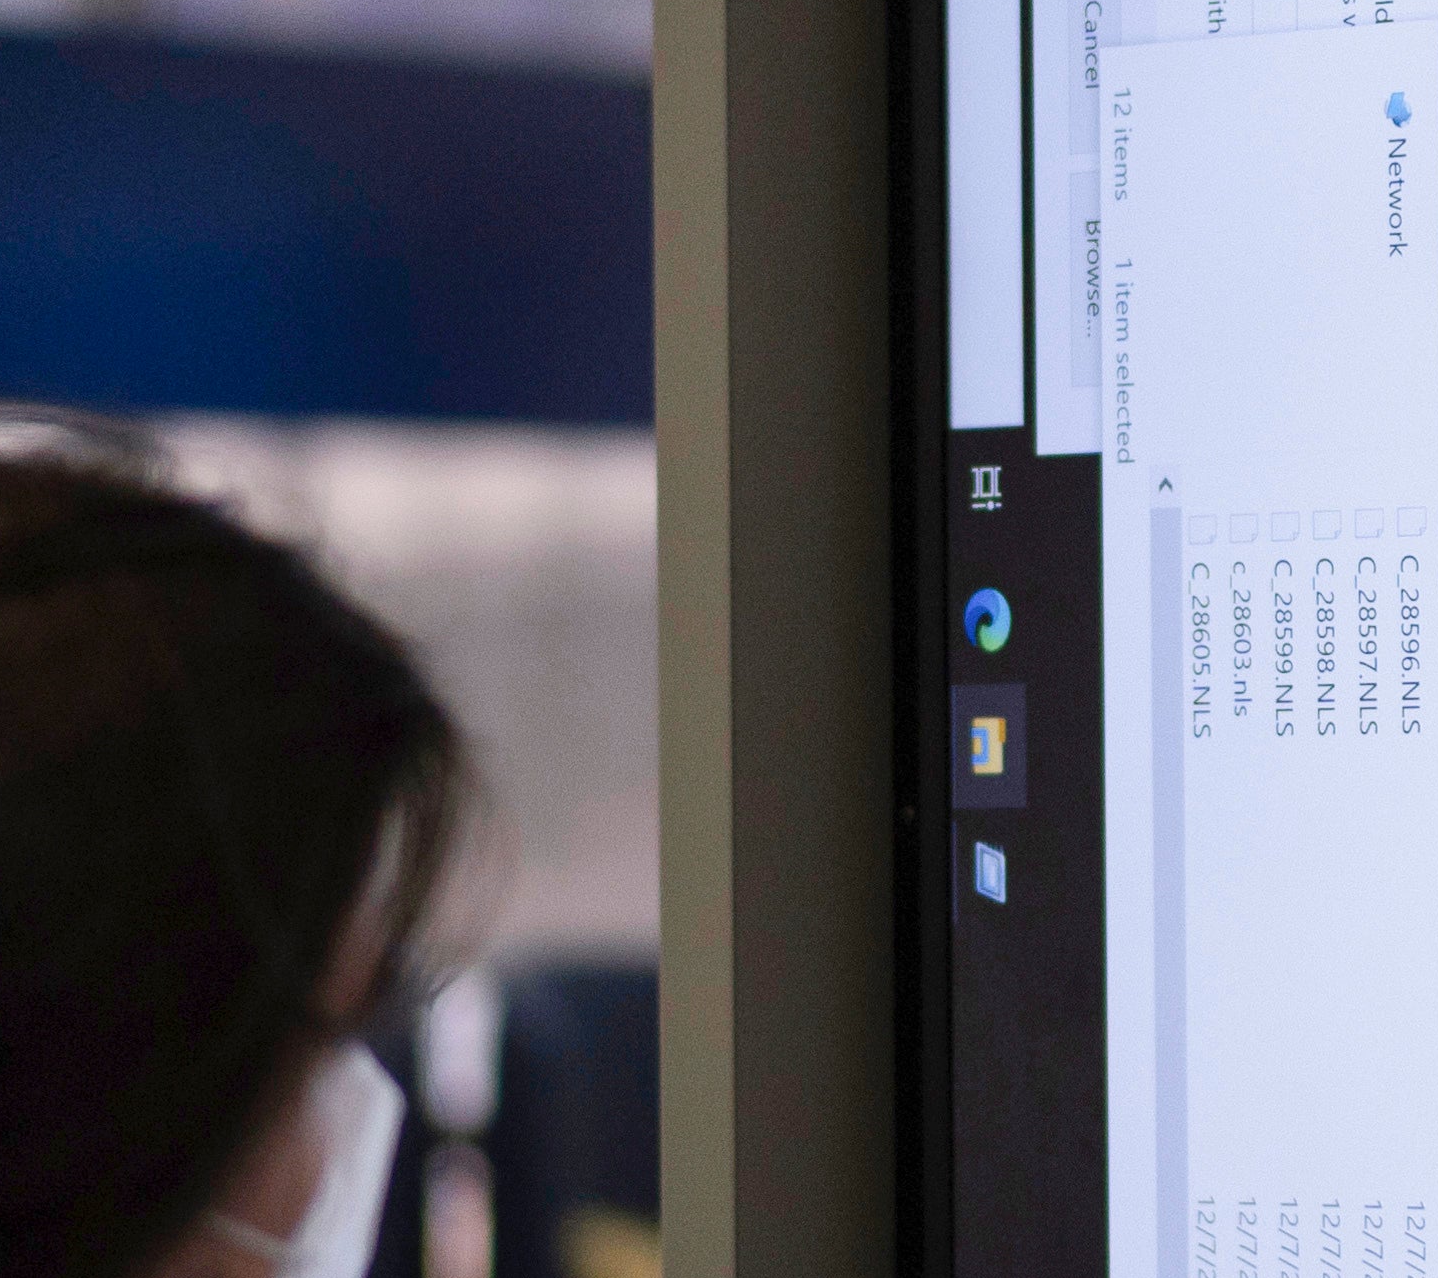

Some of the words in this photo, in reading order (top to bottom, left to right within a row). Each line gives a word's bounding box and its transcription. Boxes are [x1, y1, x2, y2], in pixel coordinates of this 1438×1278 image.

[1082, 0, 1104, 93] Cancel
[1112, 87, 1133, 118] 12
[1113, 127, 1133, 202] items
[1387, 136, 1410, 258] Network
[1114, 257, 1134, 270] 1
[1115, 281, 1135, 343] item
[1115, 351, 1136, 465] selected
[1186, 563, 1210, 740] C_28605.NLS
[1228, 559, 1254, 718] c_28603.nls
[1270, 558, 1295, 738] C_28599.NLS
[1311, 556, 1337, 738] C_28598.NLS
[1353, 555, 1379, 737] C_28597.NLS
[1395, 553, 1422, 736] C_28596.NLS
